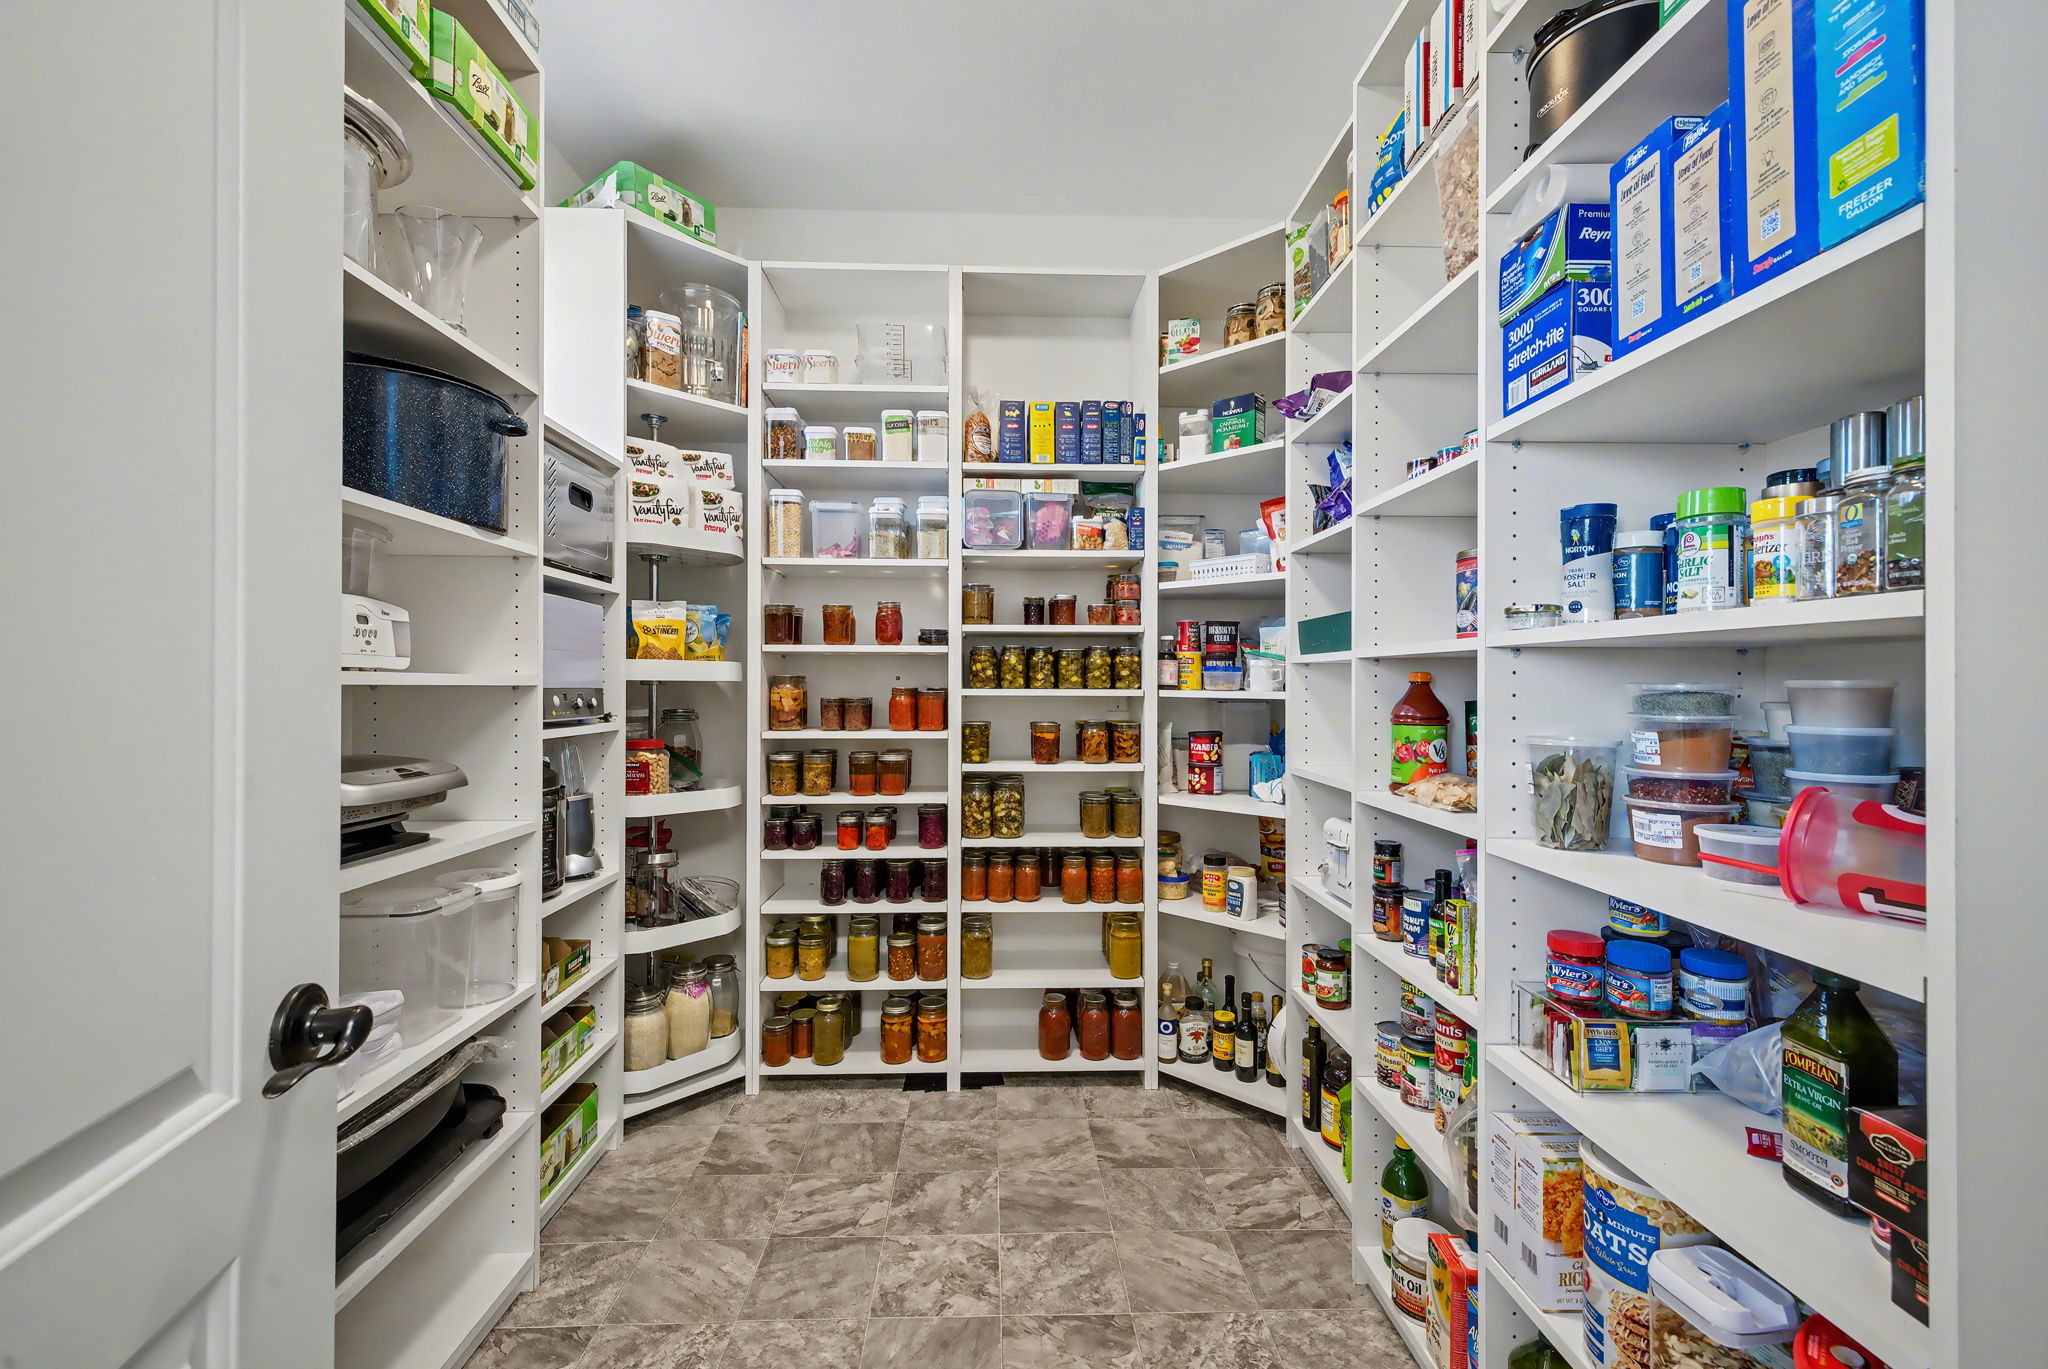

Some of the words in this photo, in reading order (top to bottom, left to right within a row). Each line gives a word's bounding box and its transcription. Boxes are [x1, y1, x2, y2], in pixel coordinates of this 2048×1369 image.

[471, 73, 491, 100] Ball
[1838, 177, 1894, 217] FREEZER
[1845, 193, 1884, 220] GALLON
[1507, 317, 1534, 348] 3000
[1507, 326, 1565, 372] stretch-tite
[1531, 353, 1566, 379] KIRKLAND
[1563, 572, 1597, 581] KOSHER
[1567, 580, 1587, 589] SALT
[651, 626, 679, 636] STINGER
[1432, 741, 1447, 760] V8
[1551, 964, 1589, 980] Wyler's
[1784, 1050, 1839, 1086] POMPEIAN
[1783, 1073, 1807, 1095] EXTRA
[1807, 1085, 1841, 1111] VIRGIN
[1812, 1101, 1823, 1112] OIL
[1790, 1138, 1829, 1168] SMOOTH
[1583, 1208, 1649, 1267] OATS
[1606, 1216, 1657, 1245] MINUTE
[1406, 1278, 1422, 1296] Oil
